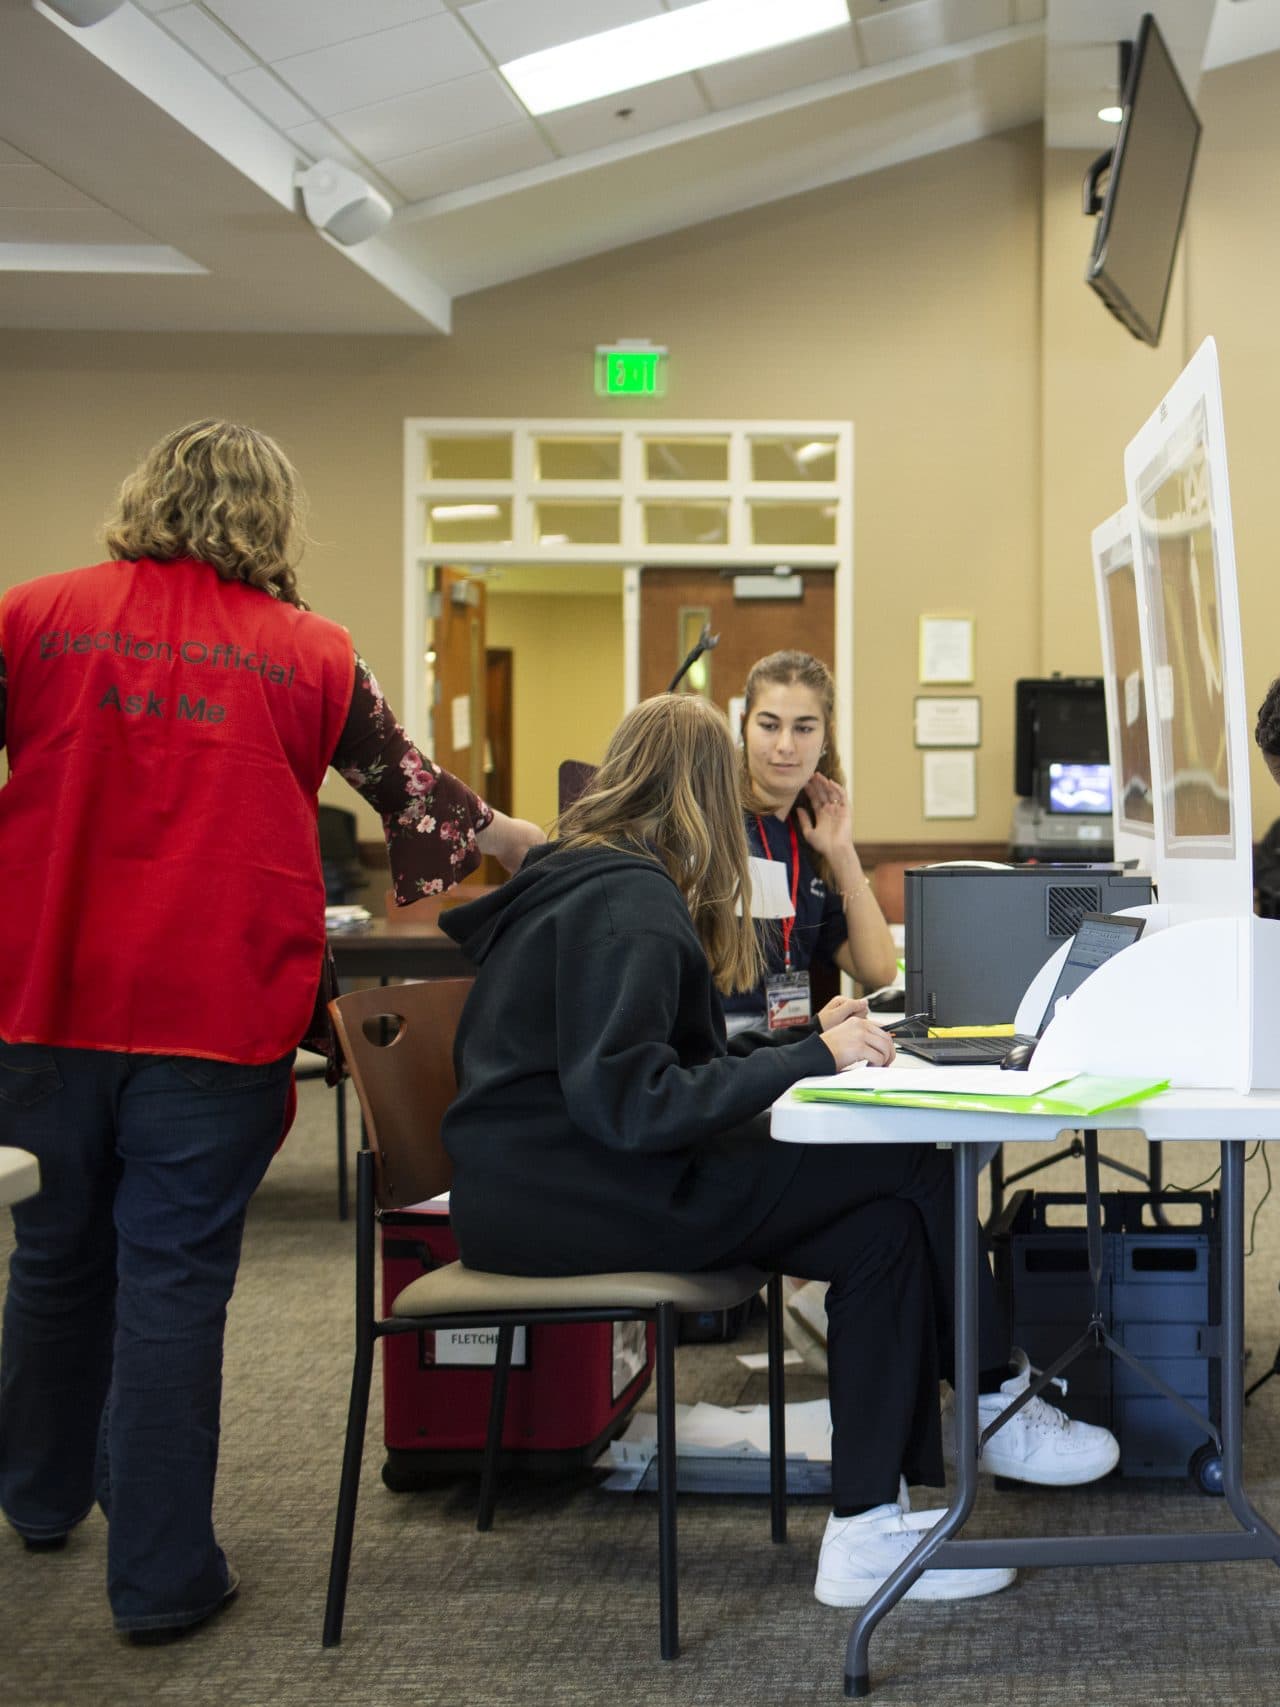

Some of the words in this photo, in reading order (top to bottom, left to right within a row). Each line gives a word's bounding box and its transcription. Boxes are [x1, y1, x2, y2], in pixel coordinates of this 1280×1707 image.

[39, 631, 172, 661] Election
[181, 641, 295, 688] Official
[98, 683, 166, 719] Ask
[176, 694, 226, 725] Me
